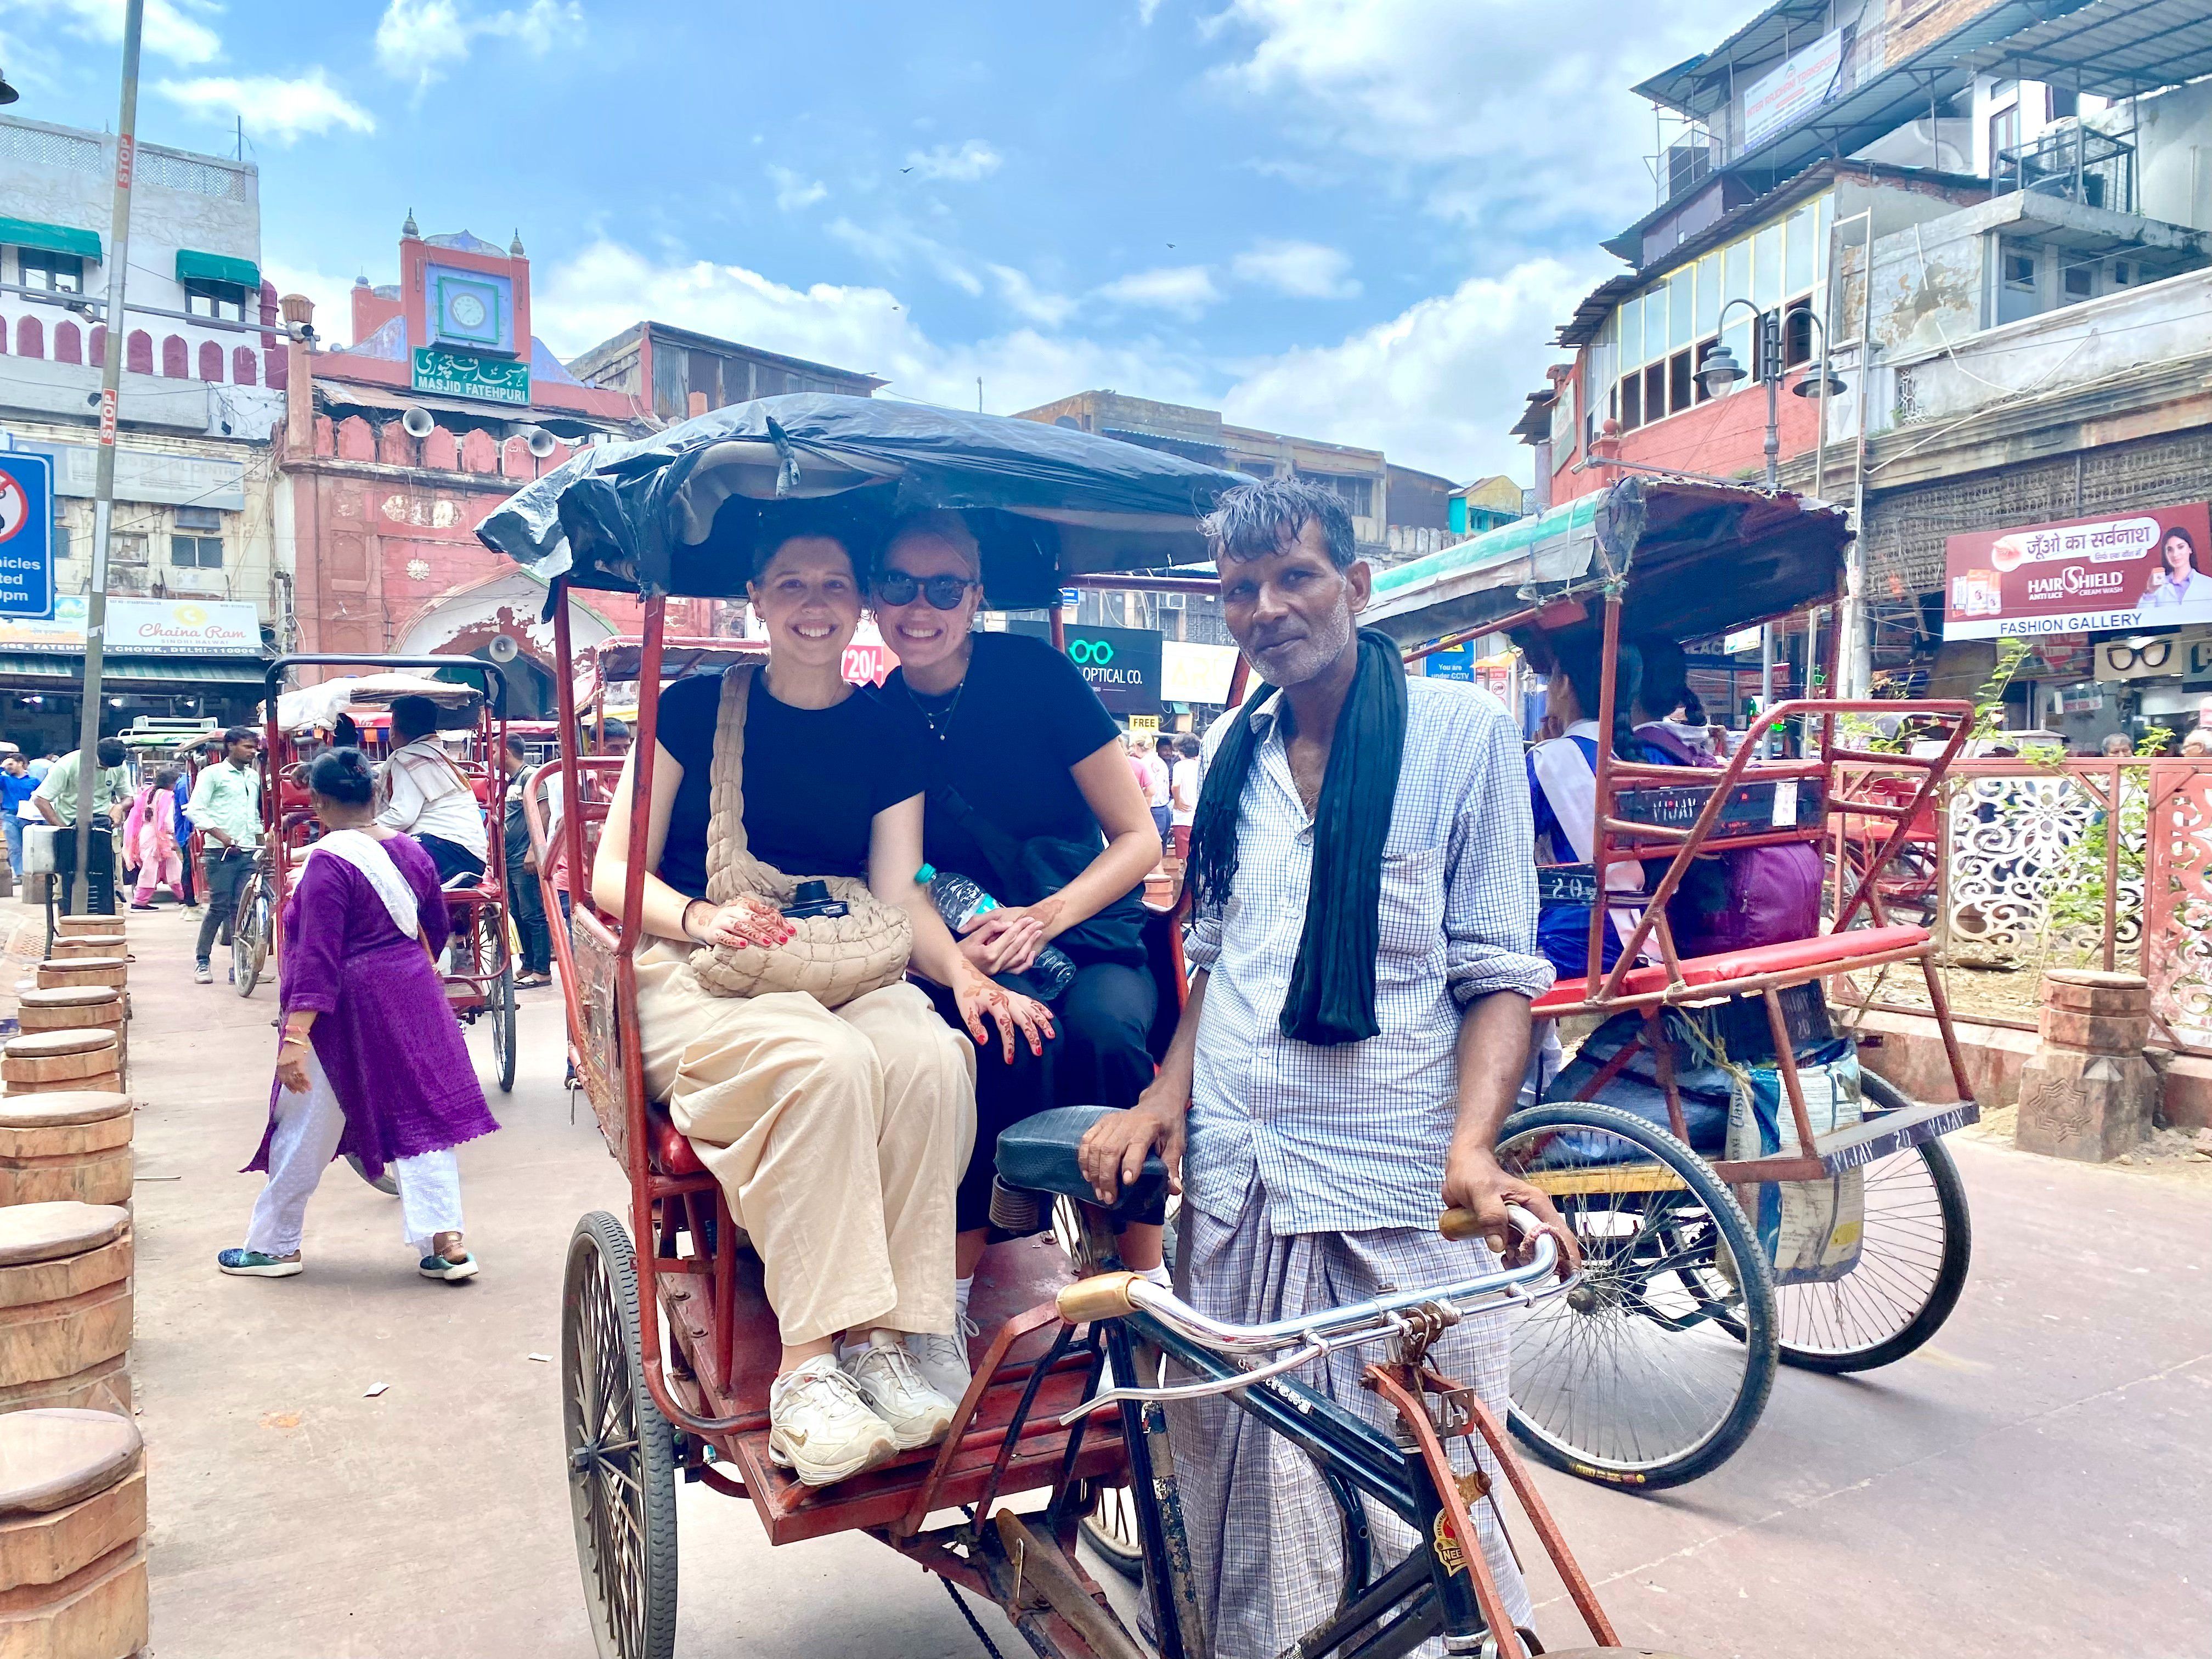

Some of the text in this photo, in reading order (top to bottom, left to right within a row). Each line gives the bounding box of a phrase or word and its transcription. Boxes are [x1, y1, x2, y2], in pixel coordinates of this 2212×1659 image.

[1797, 49, 1839, 83] TRANSPORT
[118, 138, 131, 183] STOP
[418, 376, 526, 402] MASJID FATEHPURI
[101, 393, 115, 440] STOP
[192, 463, 240, 477] CENTRE
[2065, 534, 2087, 550] का
[2090, 524, 2151, 548] सर्वनाश
[0, 556, 41, 570] icles
[2028, 567, 2123, 594] HAIR SHIELD
[2029, 592, 2047, 601] ANTI
[138, 623, 246, 639] Chaina Ram
[2000, 613, 2142, 635] FASHION GALLERY
[115, 646, 167, 654] CHOWK,
[1082, 667, 1143, 685] OPTICAL CO.
[1133, 718, 1155, 727] FREE
[1832, 1139, 1874, 1172] VIJAY
[1927, 1108, 1964, 1137] VIJAY
